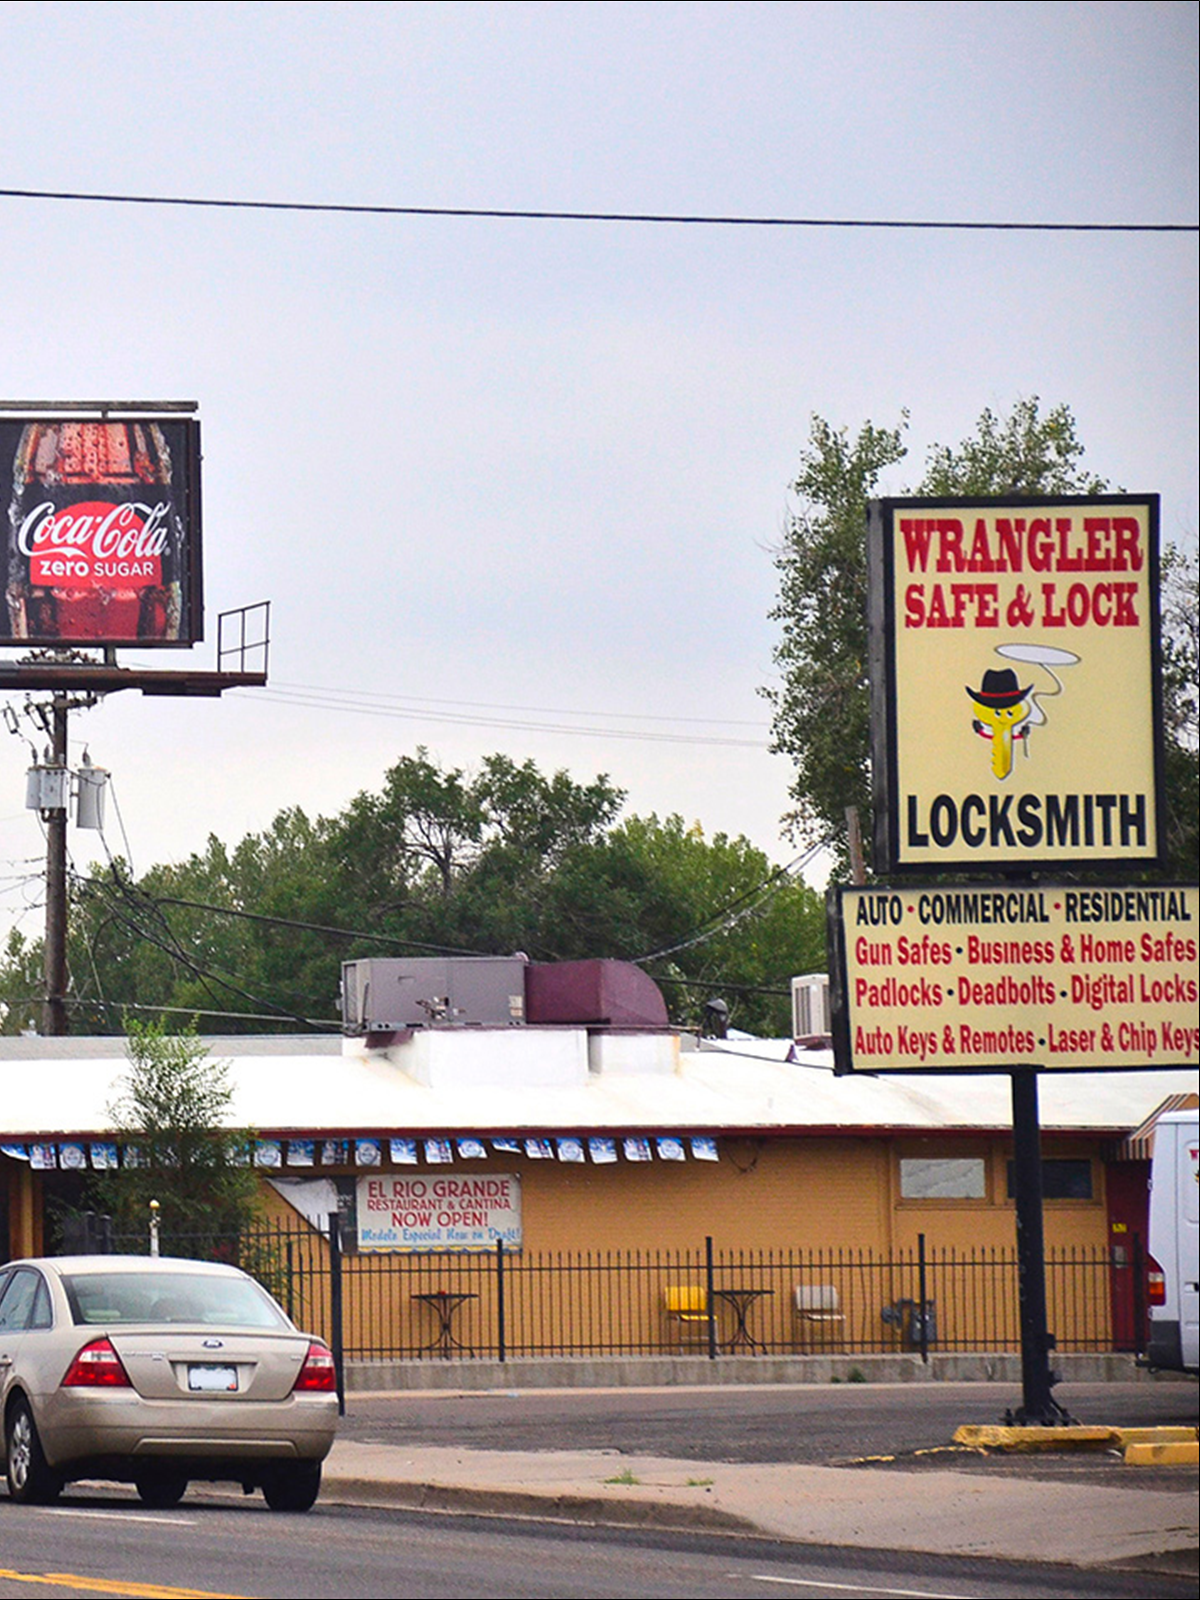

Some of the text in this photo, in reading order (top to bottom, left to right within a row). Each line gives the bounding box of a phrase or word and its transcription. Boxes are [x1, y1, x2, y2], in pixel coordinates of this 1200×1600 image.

[18, 501, 172, 559] Coca-Cola
[900, 517, 1144, 574] WRANGLER
[40, 560, 154, 577] zero SUGAR
[904, 582, 1140, 628] SAFE & LOCK
[907, 794, 1147, 848] LOCKSMITH
[856, 891, 1191, 926] AUTO COMMERCIAL RESIDENTIAL
[855, 932, 1197, 965] Gun Safes Business & Home Safes
[855, 973, 1198, 1010] Padlocks Deadbolts Digital Locks
[855, 1021, 1199, 1061] Auto Keys & Remotes Laser & Chip Keys
[367, 1199, 443, 1211] RESTAURANT
[448, 1200, 456, 1210] &
[459, 1199, 511, 1210] CANTINA
[368, 1180, 510, 1198] EL RIO GRANDE
[392, 1211, 489, 1227] NOW OPEN!
[402, 1228, 442, 1243] Especial
